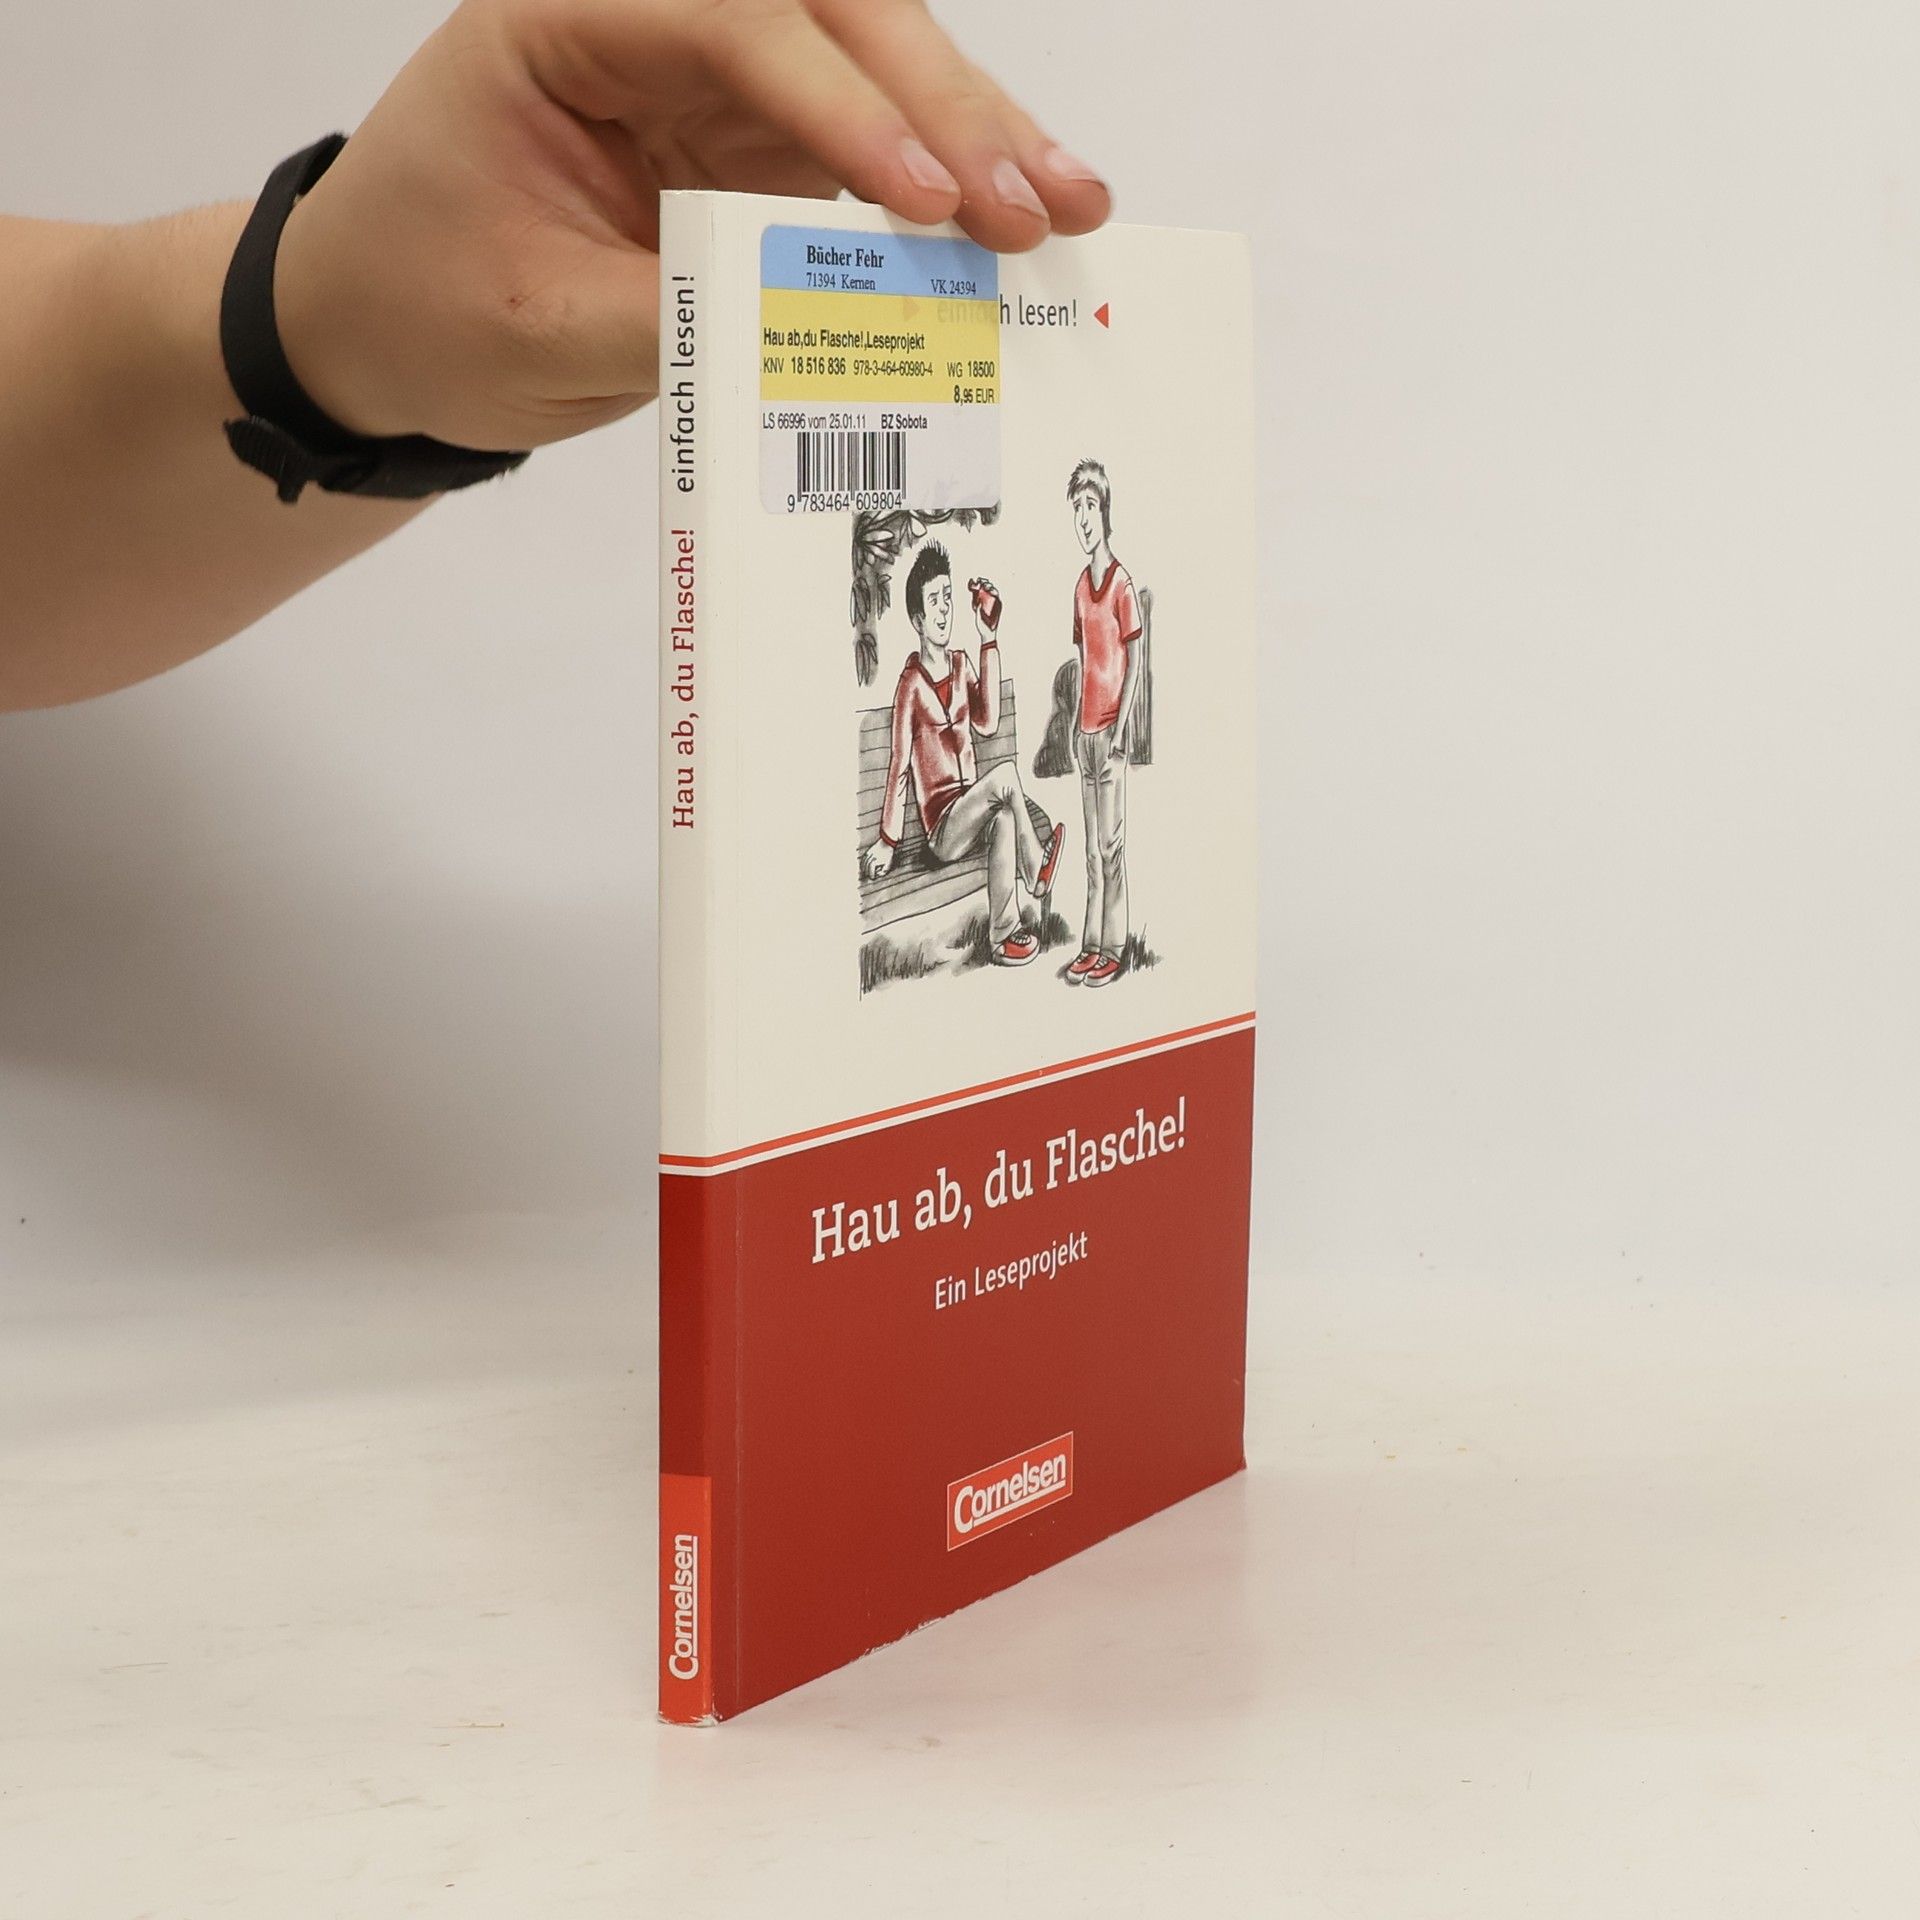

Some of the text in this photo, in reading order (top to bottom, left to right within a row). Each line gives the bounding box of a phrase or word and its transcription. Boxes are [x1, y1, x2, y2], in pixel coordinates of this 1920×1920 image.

[806, 245, 885, 268] Bücher Fehr
[806, 272, 836, 289] 71394
[931, 279, 977, 295] VK 24394
[1019, 295, 1078, 327] lesen!
[763, 327, 785, 346] Hau
[763, 356, 995, 379] KNV 18 516 836 978-3-464-60980-4 WG 18500
[670, 276, 695, 493] einfach lesen!
[975, 388, 995, 404] EUR
[762, 412, 928, 430] LS 66996 vom 25.01.11 BZ Sobota
[787, 492, 902, 512] 9 783464 609804
[671, 529, 700, 829] Hau ab, du Flasche!
[811, 1095, 1187, 1264] Hau ab, du Flasche!
[934, 1230, 1088, 1310] Ein Leseprojekt
[953, 1453, 1067, 1535] Cornelsen
[668, 1533, 699, 1681] Cornelsen
